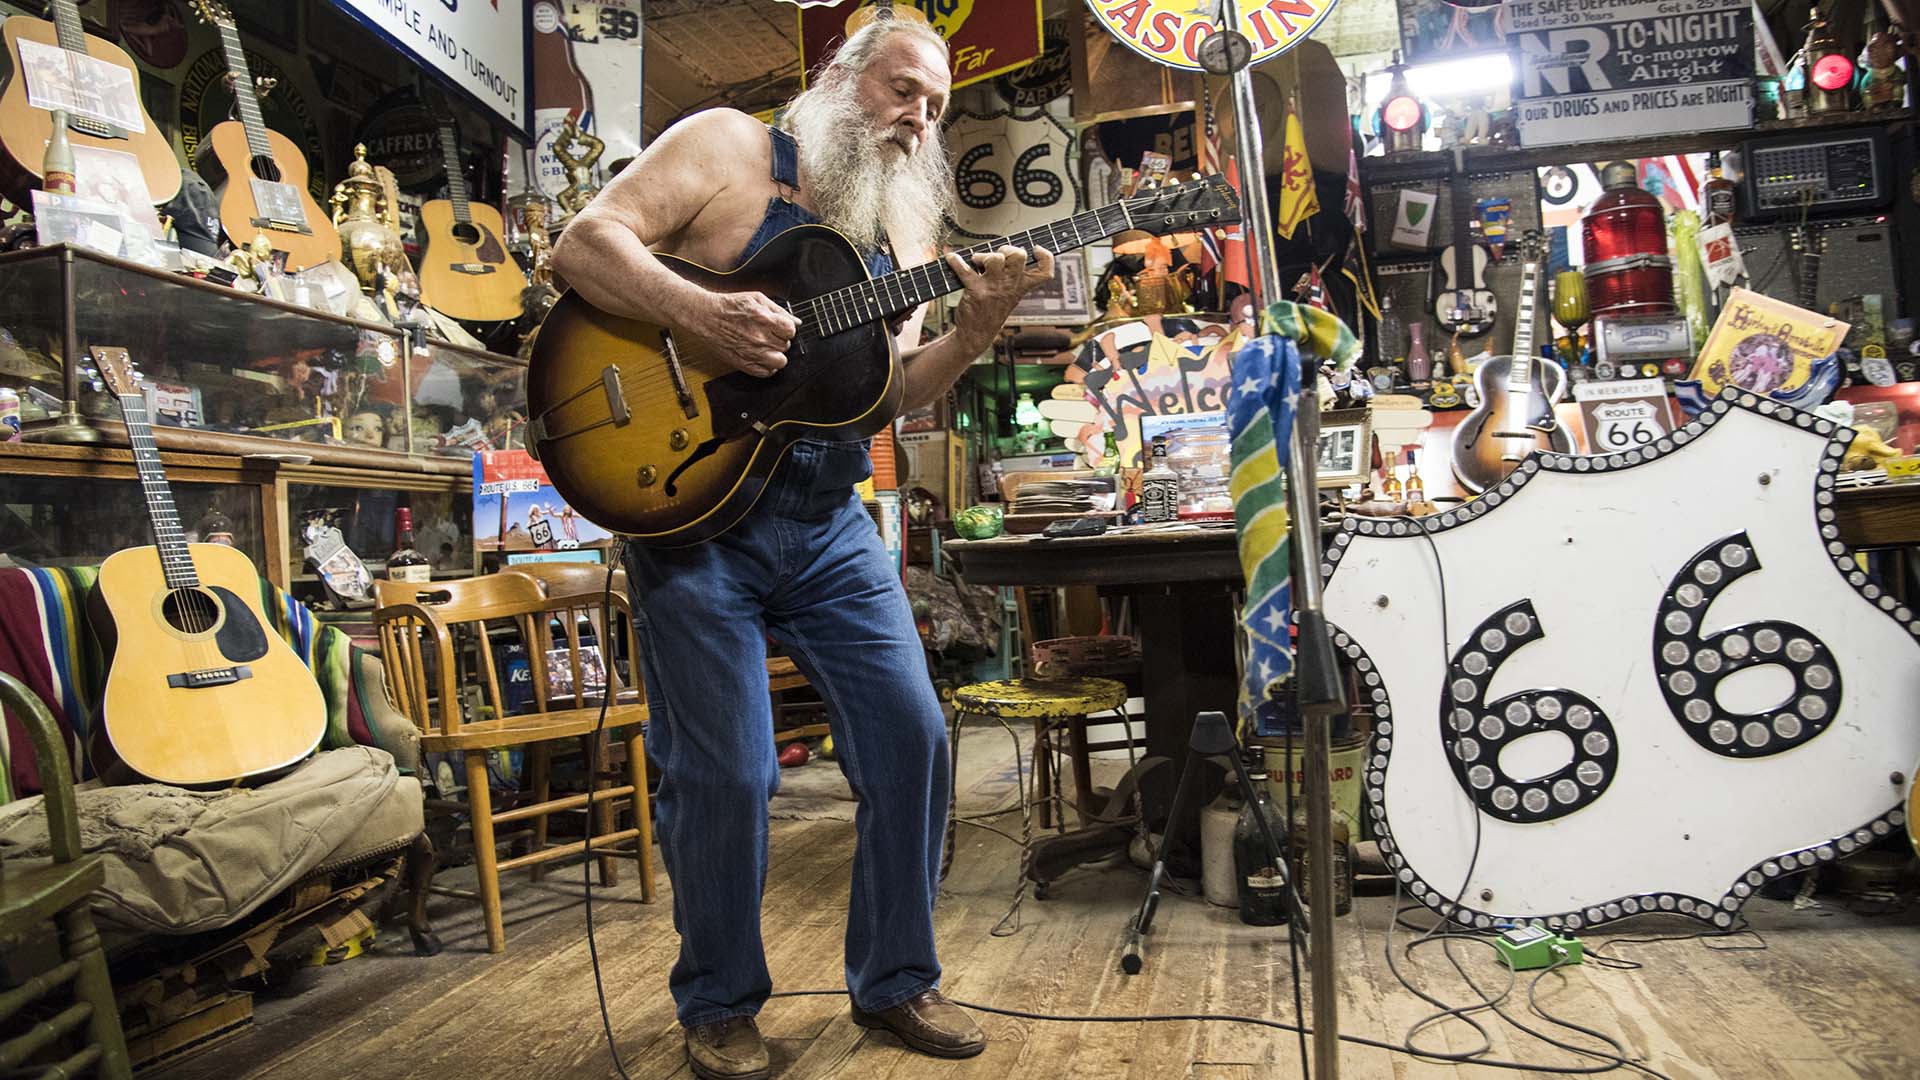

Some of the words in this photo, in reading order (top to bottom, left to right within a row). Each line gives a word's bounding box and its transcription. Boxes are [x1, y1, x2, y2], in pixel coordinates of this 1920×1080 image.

[1509, 1, 1533, 17] THE
[1513, 17, 1539, 29] Used
[1543, 16, 1557, 25] for
[1560, 13, 1579, 25] 30
[1583, 11, 1614, 22] Years
[1657, 3, 1681, 13] Get
[599, 8, 639, 39] 39
[1611, 11, 1741, 50] TO-NIGHT
[428, 24, 457, 60] AND
[462, 48, 518, 107] TURNOUT
[954, 44, 995, 75] Far
[1520, 26, 1612, 97] NR
[1616, 43, 1740, 66] To-morrow
[182, 50, 226, 112] NATIONA
[1629, 59, 1724, 83] Alright
[1014, 79, 1072, 105] PARTS
[1524, 107, 1549, 122] OUR
[1553, 97, 1600, 119] DRUGS
[1603, 99, 1630, 114] AND
[1632, 90, 1679, 112] PRICES
[1680, 92, 1704, 107] ARE
[1706, 83, 1745, 104] RIGHT
[1154, 124, 1195, 162] BE
[955, 143, 1063, 209] 66
[1598, 385, 1639, 396] MEMORY
[1643, 384, 1654, 392] OF
[1604, 407, 1645, 417] ROUTE
[1608, 421, 1653, 446] 66
[482, 483, 504, 494] ROUTE
[522, 480, 534, 490] 66
[535, 526, 549, 541] 66
[511, 555, 532, 563] ROUTE
[511, 669, 532, 682] KE
[1440, 528, 1843, 823] 66
[1328, 766, 1354, 782] ARD
